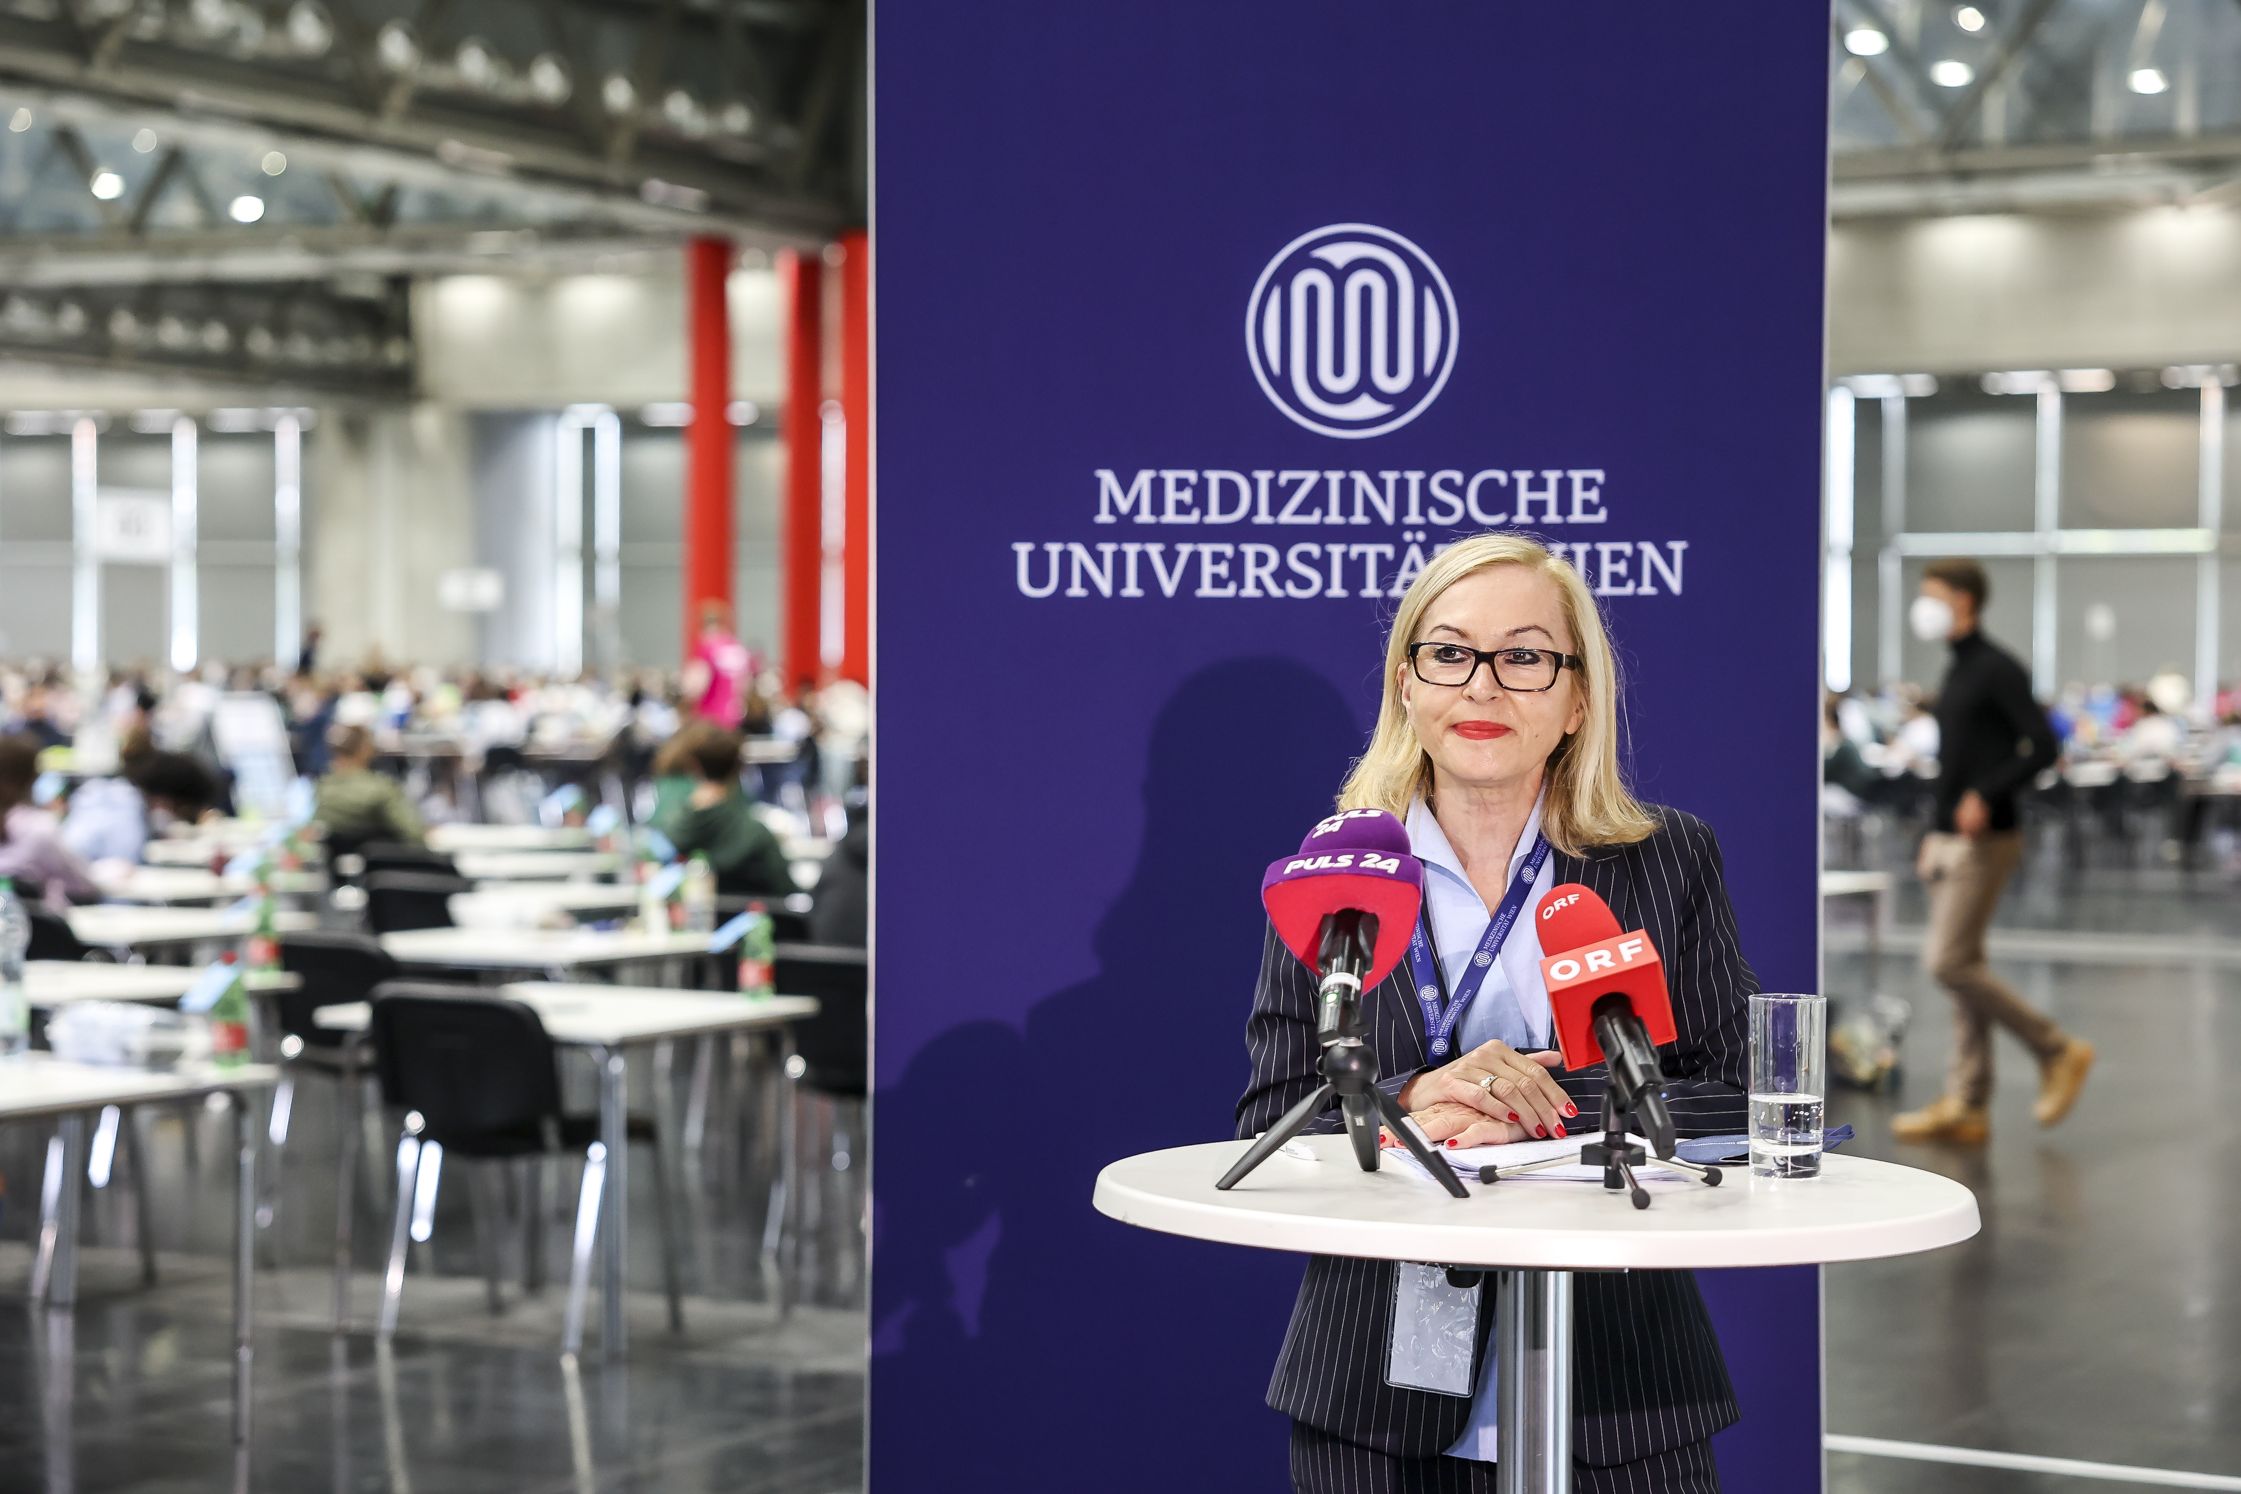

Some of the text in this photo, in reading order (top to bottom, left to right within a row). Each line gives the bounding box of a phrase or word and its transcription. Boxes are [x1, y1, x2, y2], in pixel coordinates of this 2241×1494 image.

[1093, 468, 1608, 525] MEDIZINISCHE
[1011, 530, 1690, 599] UNIVERSITÄ IEN
[1283, 853, 1401, 875] PULS 24
[1506, 904, 1518, 920] WIEN
[1542, 893, 1580, 920] ORF
[1549, 937, 1644, 981] ORF
